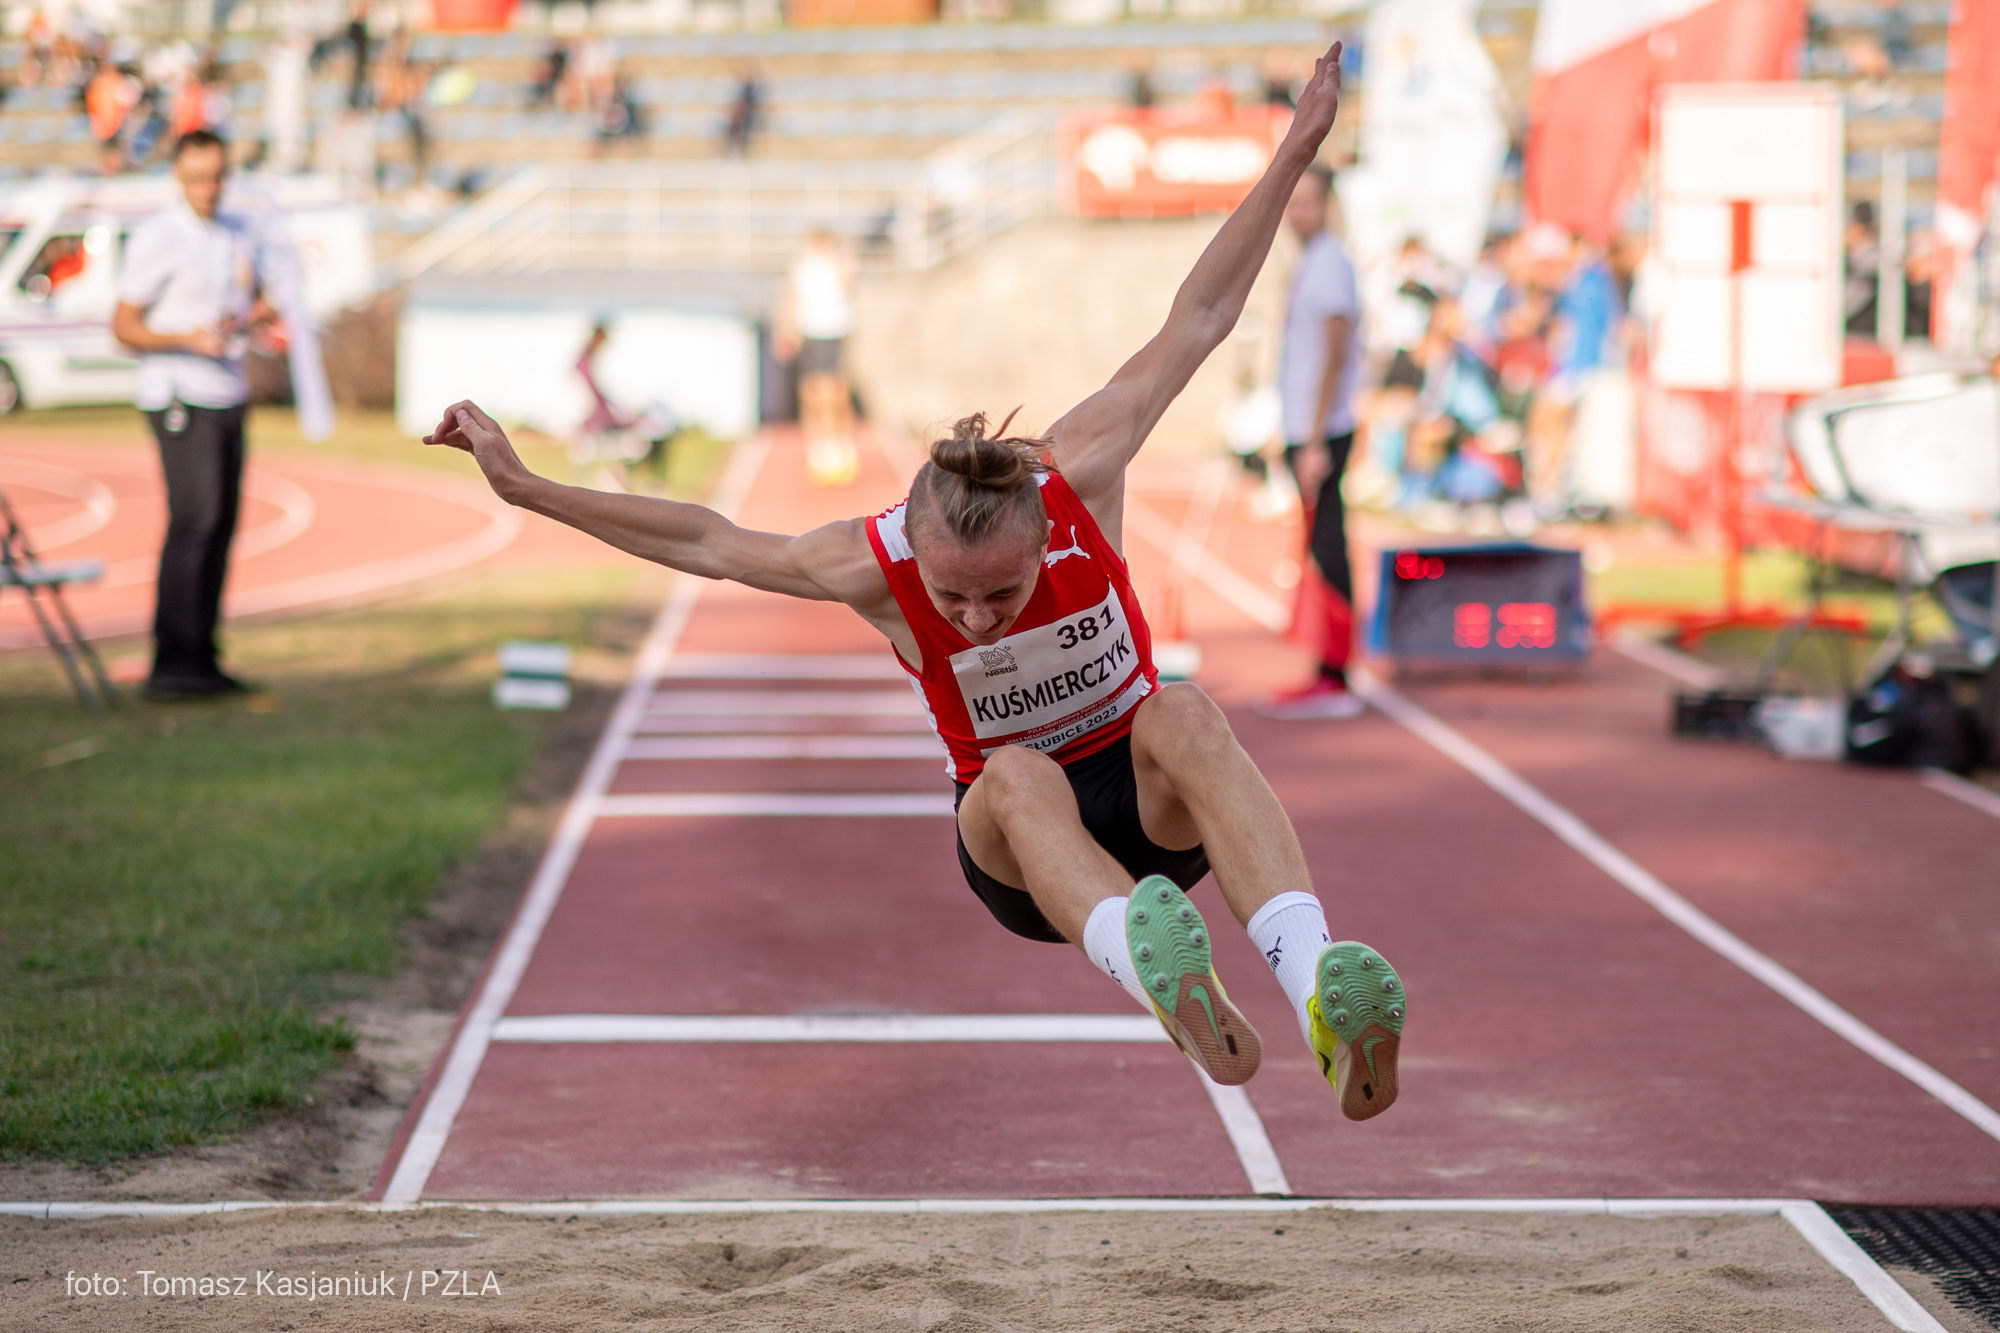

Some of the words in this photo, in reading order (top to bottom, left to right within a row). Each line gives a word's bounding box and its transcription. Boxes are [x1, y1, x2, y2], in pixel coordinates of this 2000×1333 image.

[1056, 604, 1115, 650] 381
[972, 631, 1131, 722] KUŚMIERCZYK
[985, 663, 1019, 678] Nestlé
[1027, 727, 1043, 735] PZLA
[1044, 711, 1080, 730] Mistrzostwa
[1057, 715, 1084, 731] JANUSZA
[1086, 705, 1118, 729] 2023
